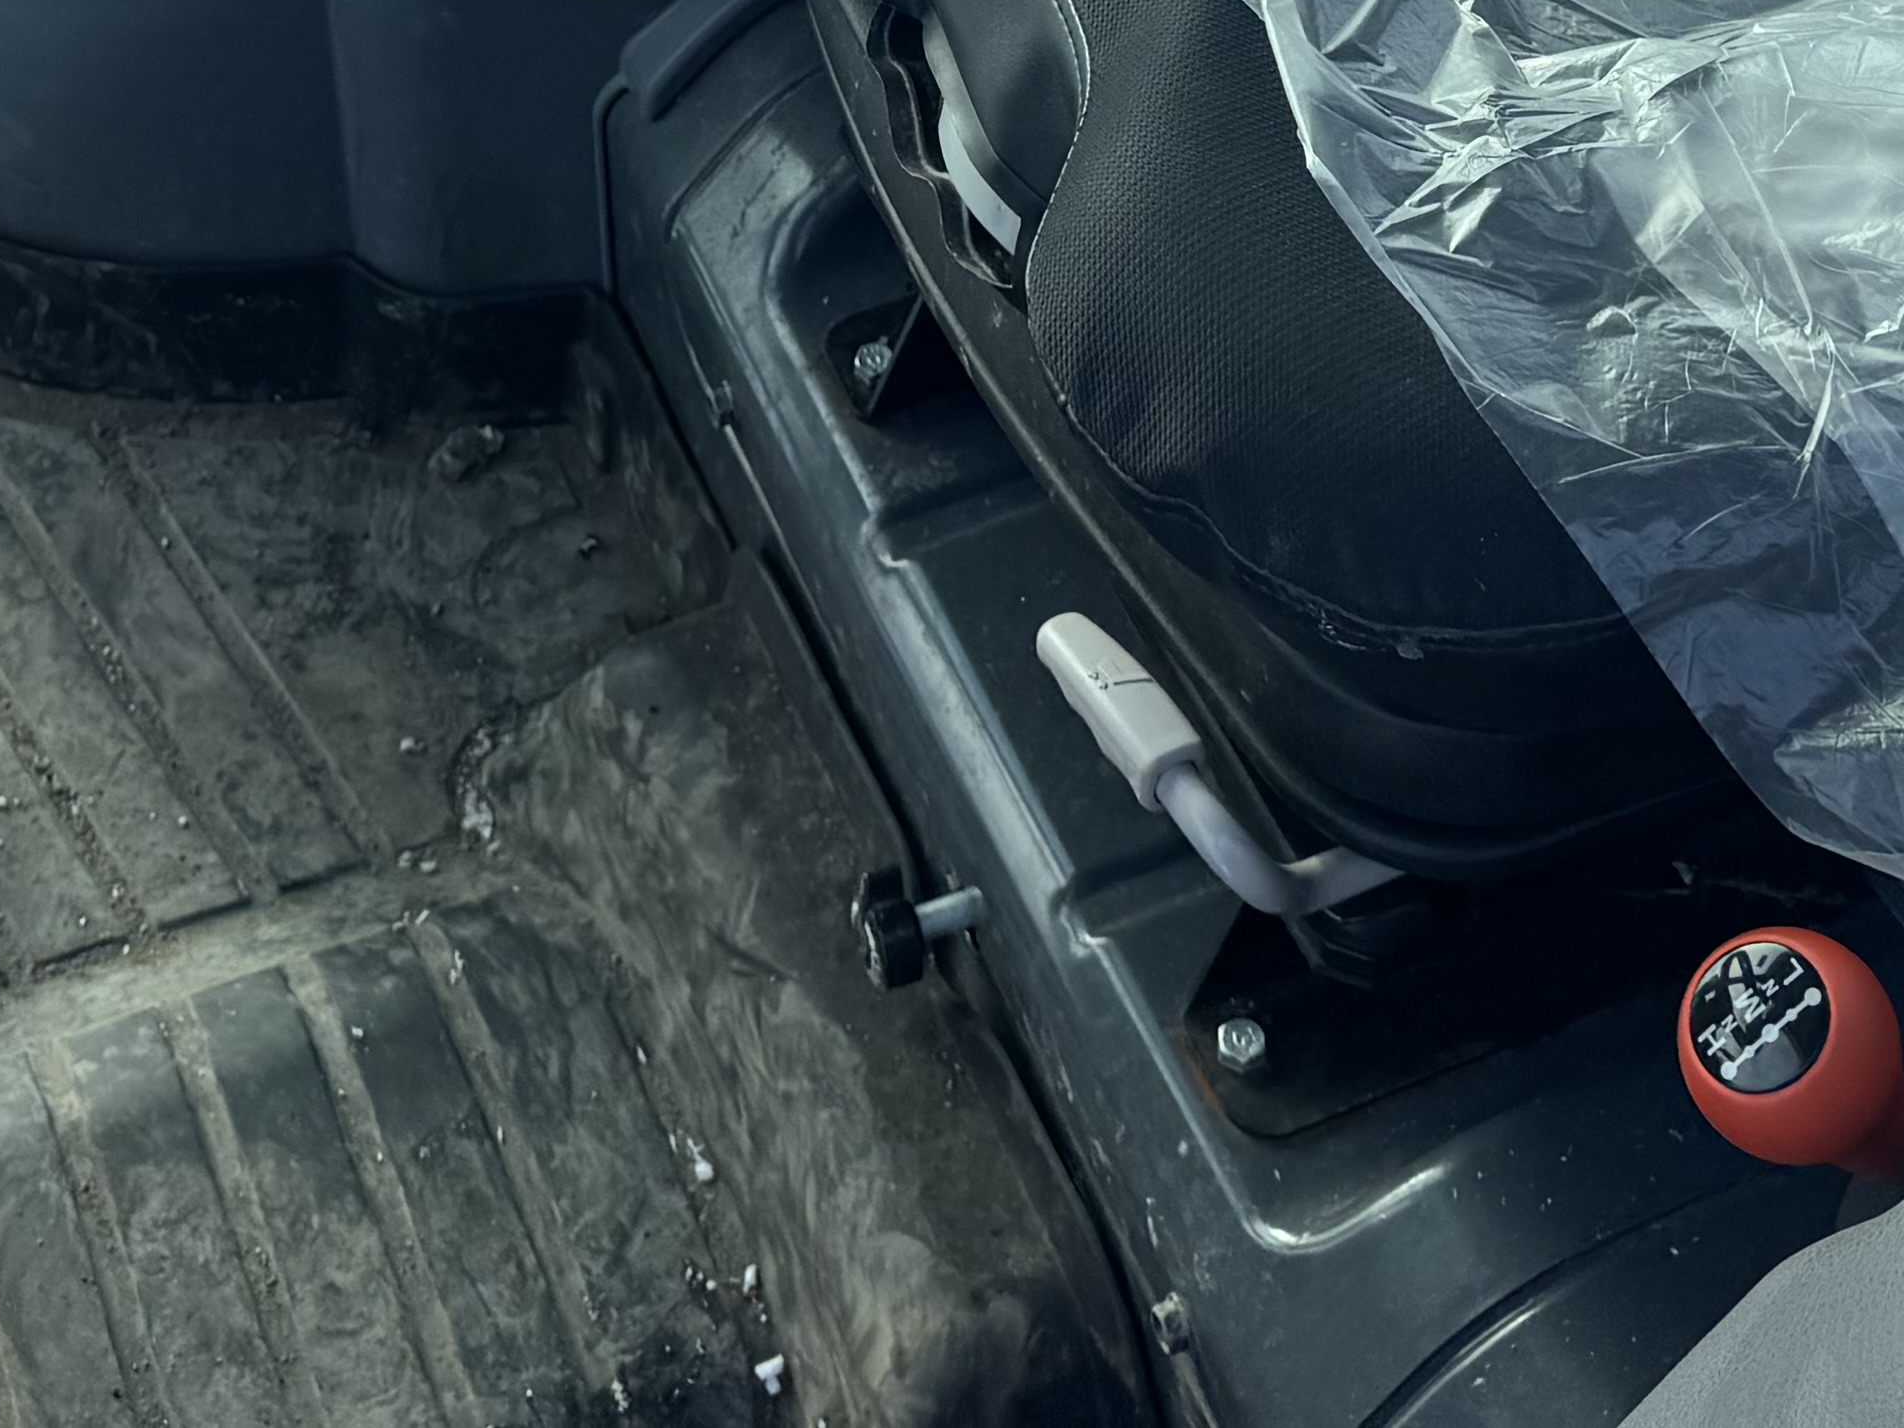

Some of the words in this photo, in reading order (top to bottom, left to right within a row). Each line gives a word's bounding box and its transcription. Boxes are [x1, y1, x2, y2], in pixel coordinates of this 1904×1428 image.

[1697, 1024, 1726, 1056] H
[1733, 988, 1766, 1023] M
[1783, 957, 1804, 985] L
